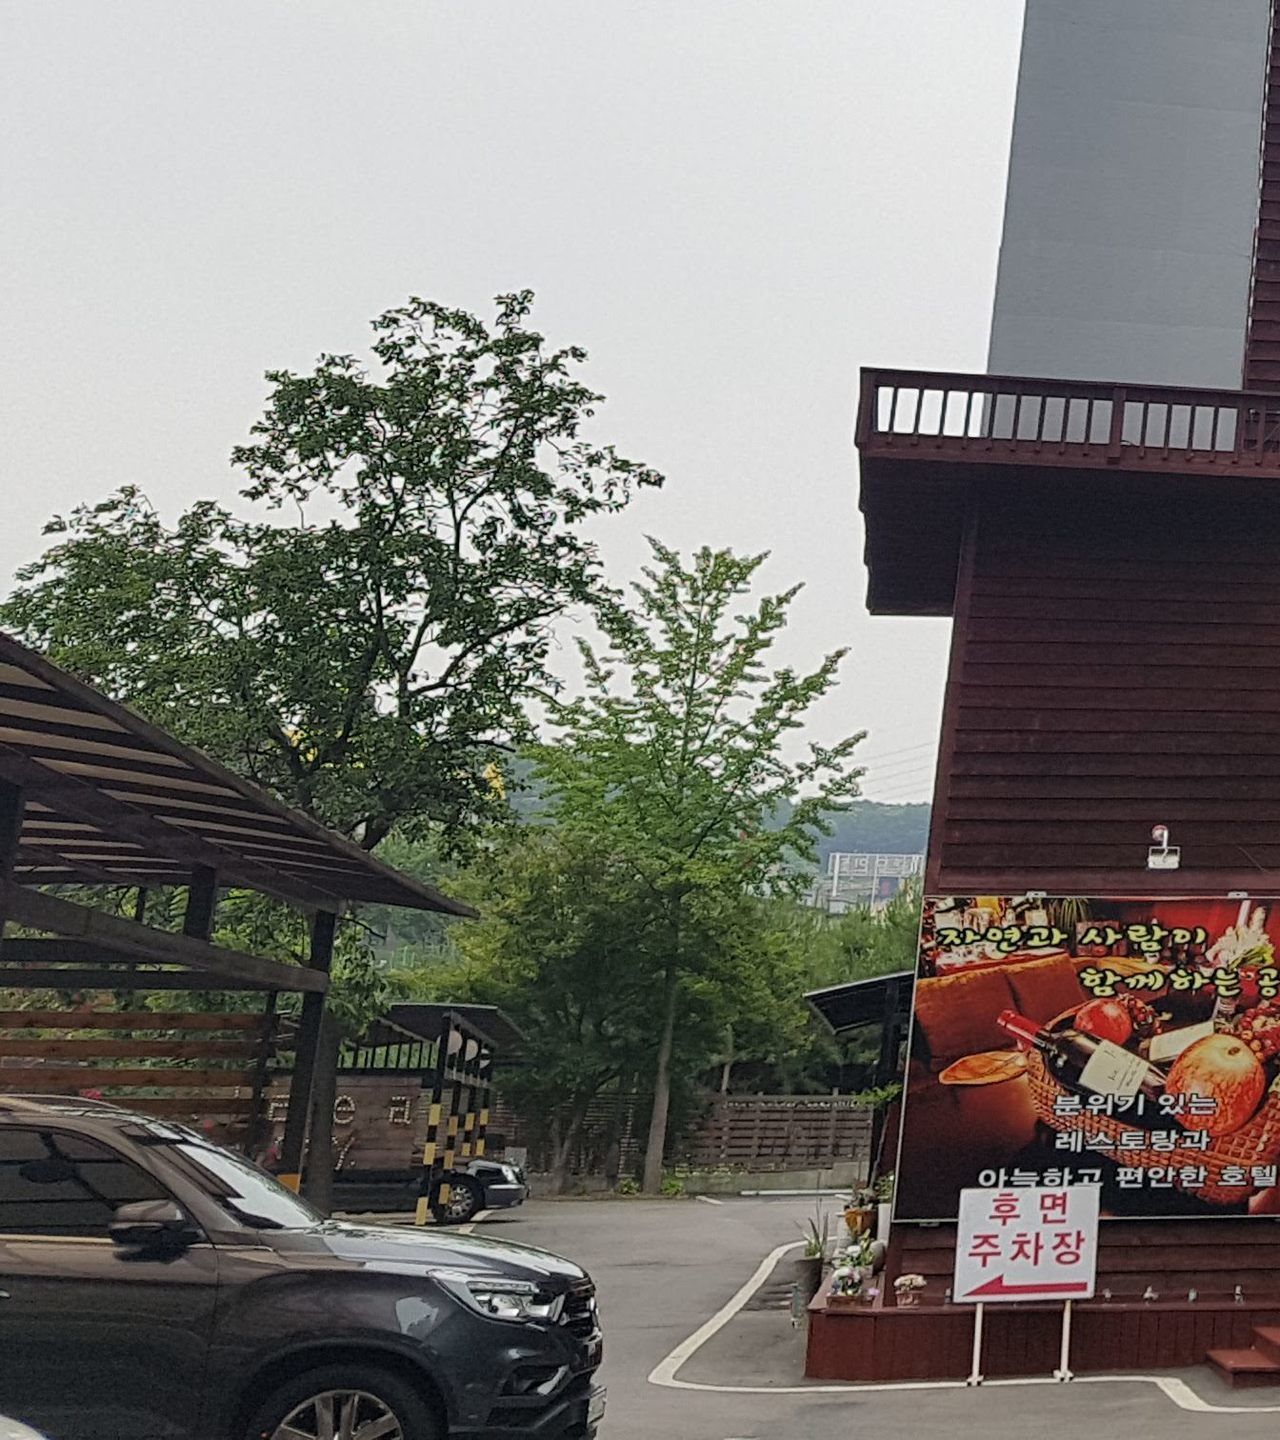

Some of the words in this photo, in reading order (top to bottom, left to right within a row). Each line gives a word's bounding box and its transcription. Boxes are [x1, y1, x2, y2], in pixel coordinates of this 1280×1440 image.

[935, 926, 1069, 953] 자연과
[1081, 925, 1207, 954] 사람이
[1079, 968, 1243, 997] 함께하는
[1052, 1094, 1145, 1116] 분위기
[1158, 1094, 1217, 1116] 있는
[1055, 1129, 1211, 1152] 레스토랑과
[978, 1167, 1103, 1188] 아늑하고
[1116, 1166, 1208, 1188] 편안한
[1217, 1165, 1278, 1187] 호텔
[968, 1230, 1086, 1267] 주차장
